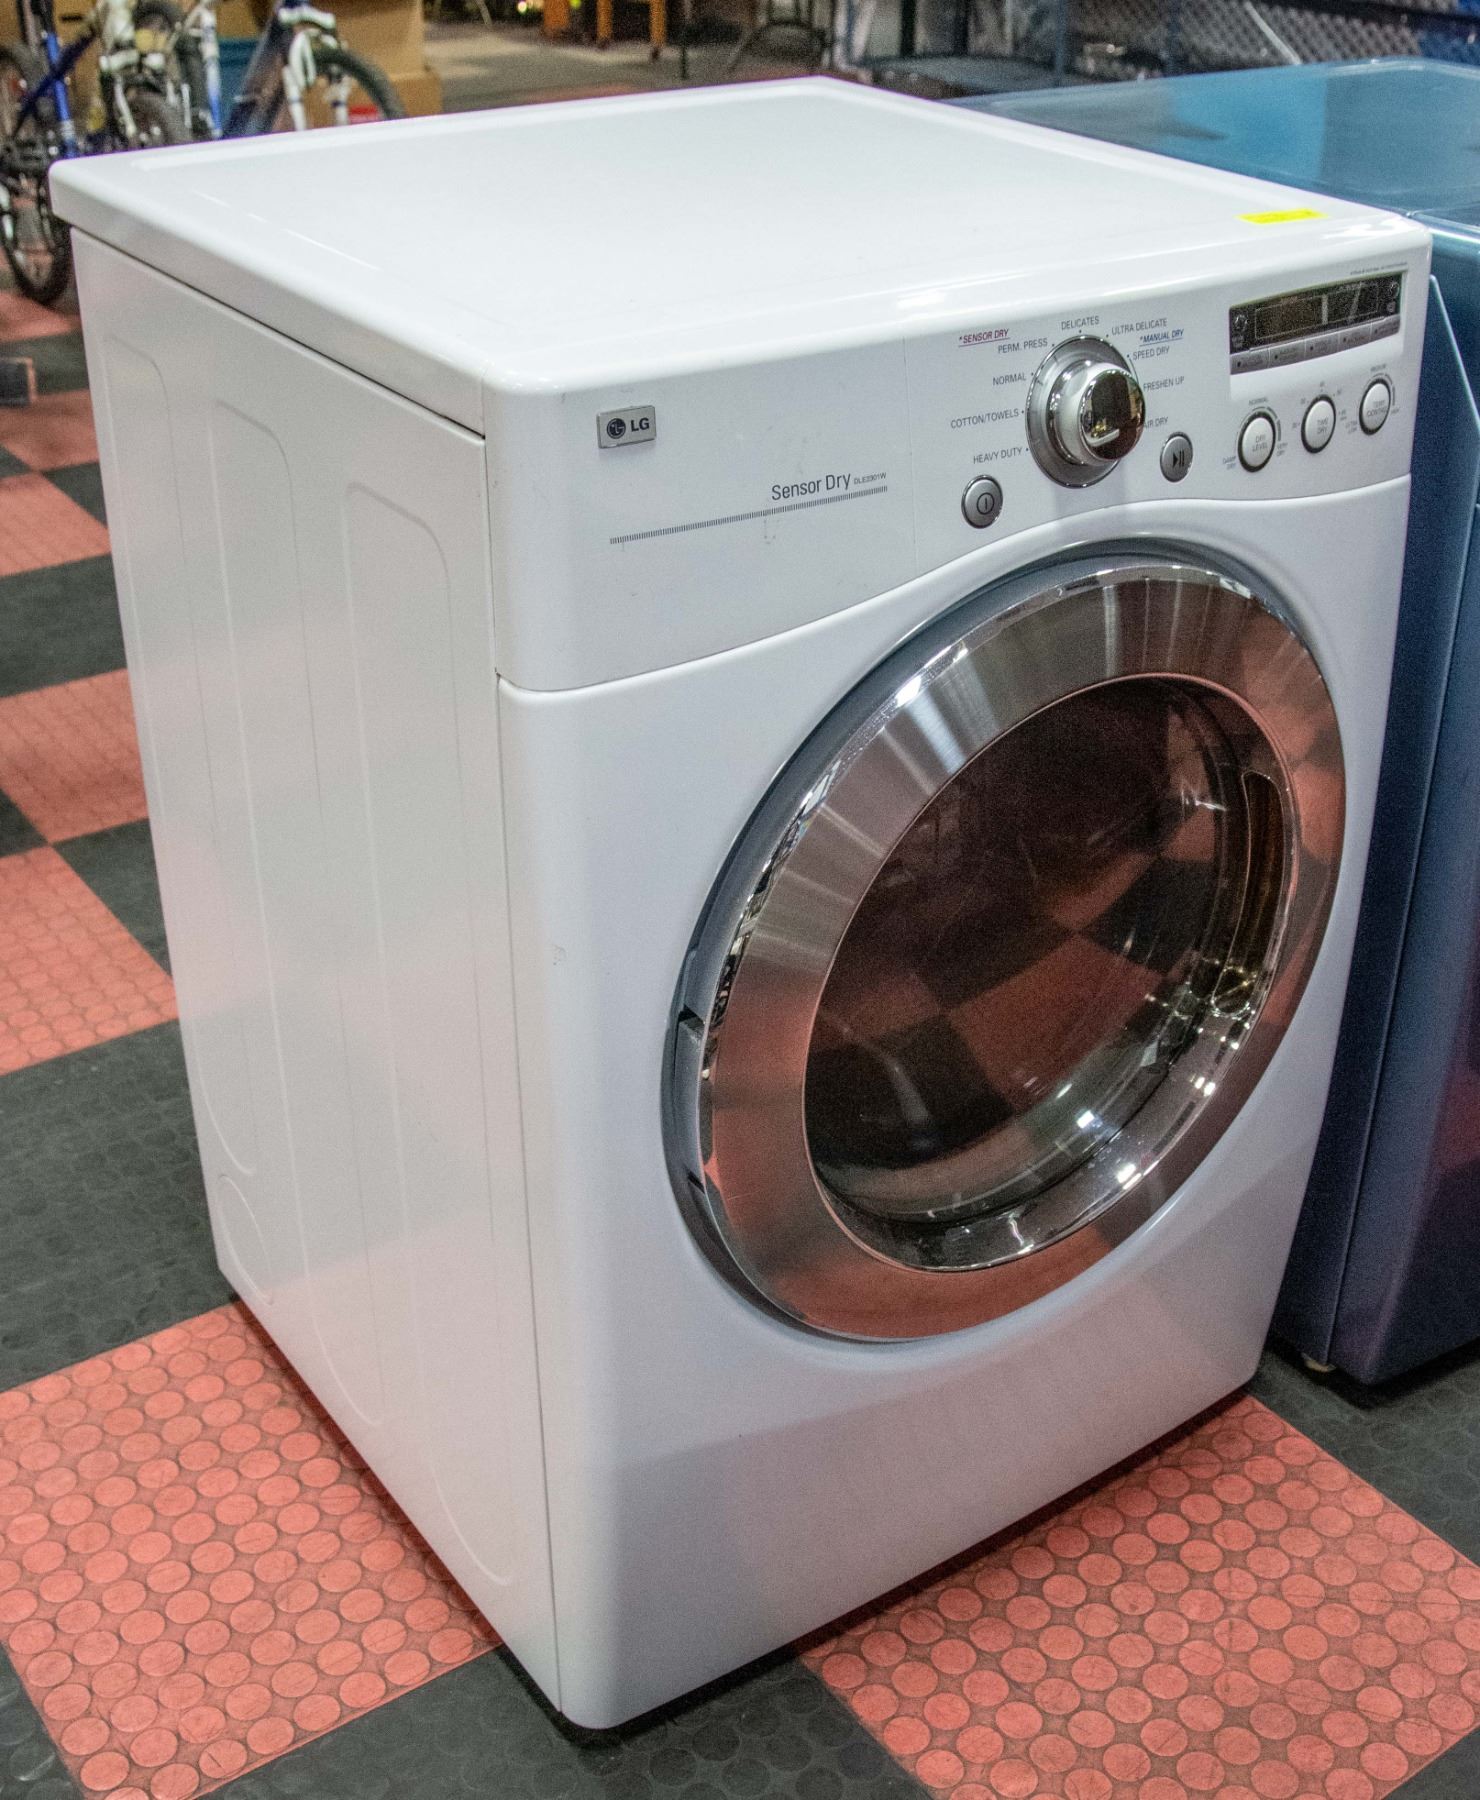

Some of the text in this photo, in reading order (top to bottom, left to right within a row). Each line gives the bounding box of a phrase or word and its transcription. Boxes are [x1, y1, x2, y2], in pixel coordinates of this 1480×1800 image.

[1061, 316, 1099, 330] DELICATES
[1112, 318, 1168, 335] ULTRA DELICATE
[994, 328, 1009, 339] DRY
[1171, 328, 1184, 338] DRY
[998, 338, 1048, 354] PERM. PRESS
[1133, 346, 1170, 360] SPEED DRY
[992, 374, 1026, 386] NORMAL
[1143, 376, 1185, 391] FRESHEN UP
[631, 417, 650, 432] LG
[951, 408, 1019, 429] COTTON/TOWELS
[1155, 416, 1168, 427] DRY
[973, 447, 1023, 464] HEAVY DUTY
[771, 479, 822, 501] Sensor
[825, 473, 851, 491] Dry
